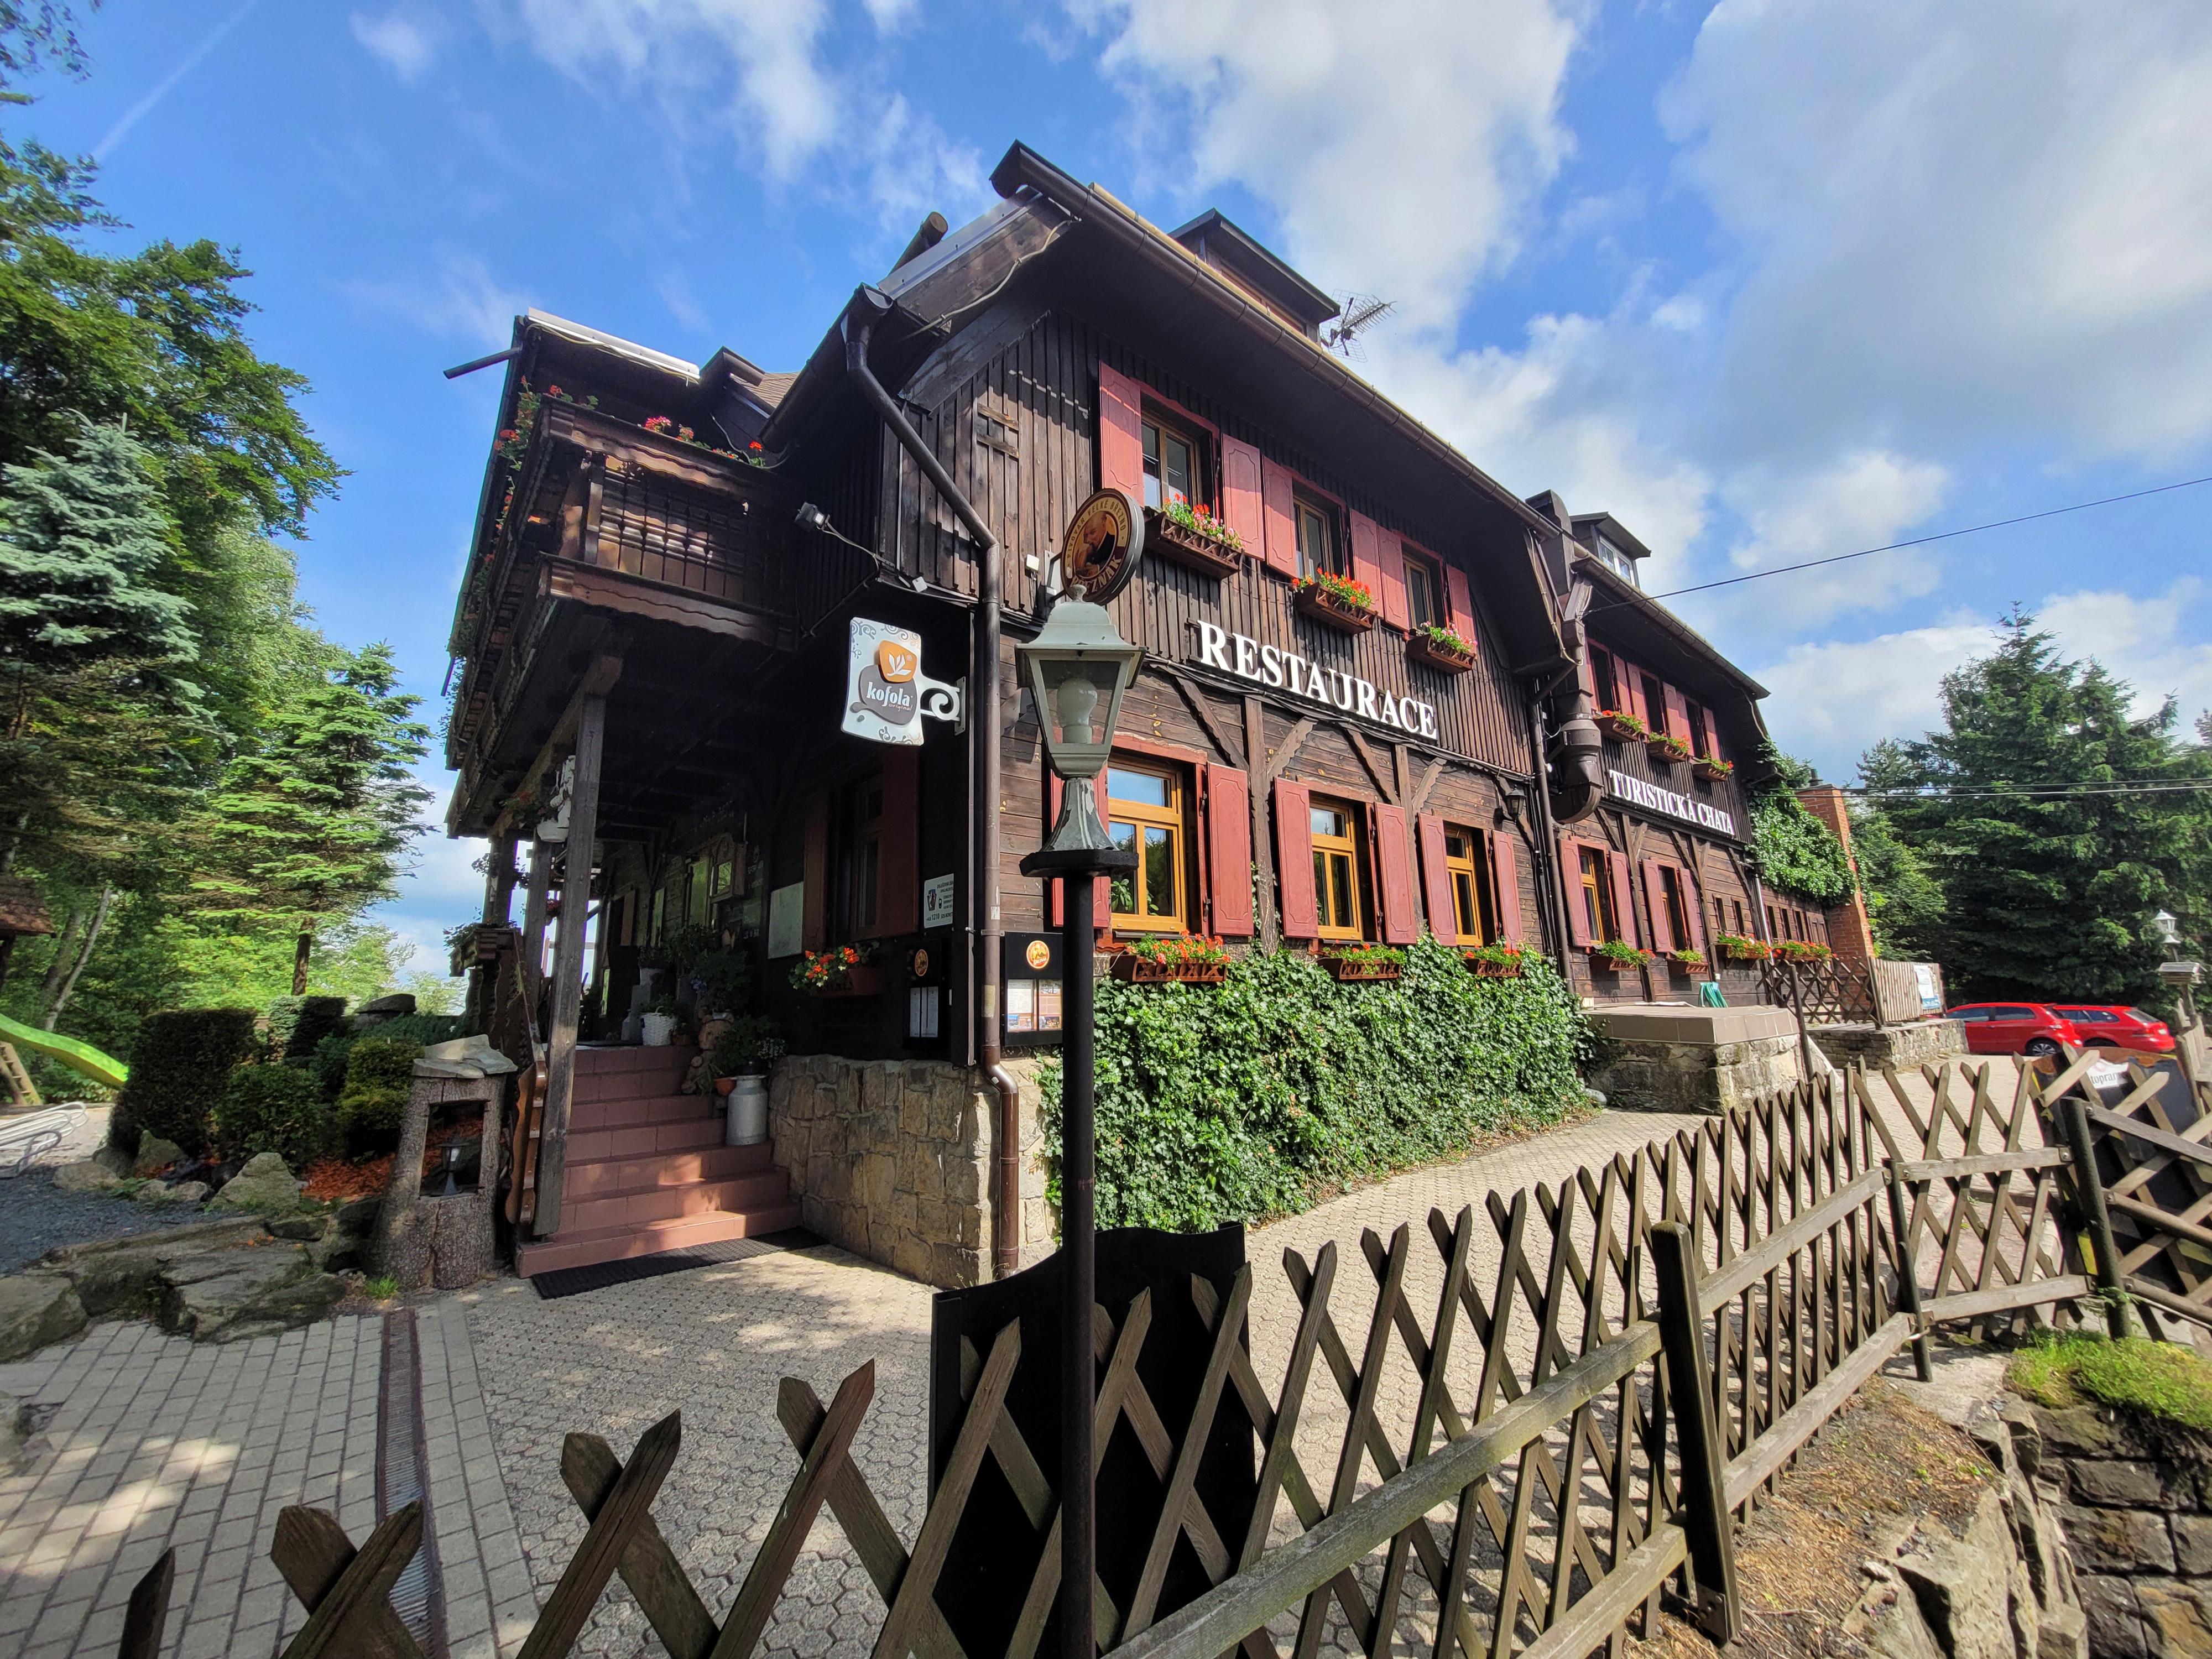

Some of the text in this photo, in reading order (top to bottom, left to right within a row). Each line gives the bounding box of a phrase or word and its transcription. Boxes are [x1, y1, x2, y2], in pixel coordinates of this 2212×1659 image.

[1066, 499, 1126, 559] PIVOVAR VELKÉ BŘEZNO
[866, 681, 911, 707] kofola
[889, 703, 913, 712] original
[1196, 619, 1438, 740] RESTAURACE
[1609, 769, 1735, 836] TURISTICKÁ CHATA
